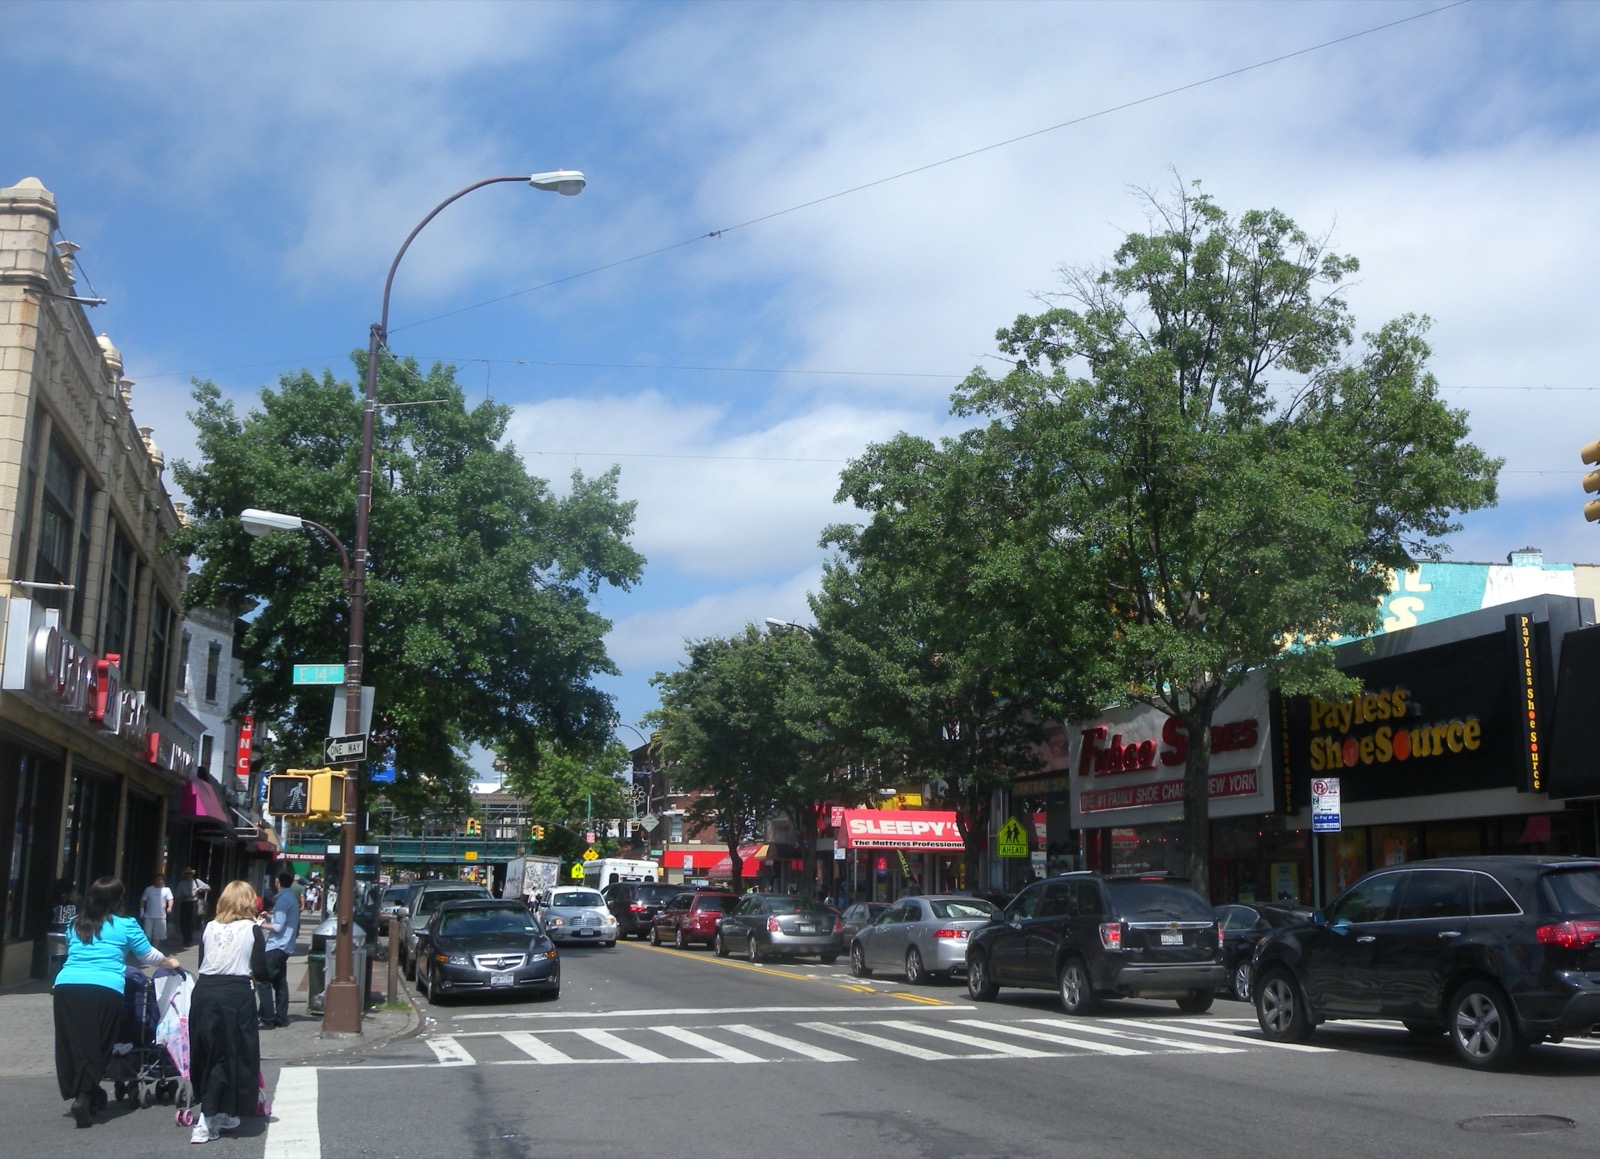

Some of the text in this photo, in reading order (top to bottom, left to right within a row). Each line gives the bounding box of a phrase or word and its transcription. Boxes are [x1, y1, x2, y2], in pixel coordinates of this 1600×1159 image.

[299, 668, 308, 682] E
[314, 668, 327, 682] 14
[1310, 689, 1407, 734] Payless
[330, 742, 361, 757] ONE WAY
[1310, 719, 1482, 771] ShoeSource
[1106, 790, 1135, 807] FAMILY
[1136, 785, 1159, 802] SHOE
[1229, 773, 1257, 792] YORK
[872, 840, 911, 848] Mattress
[1002, 846, 1024, 855] AHEAD
